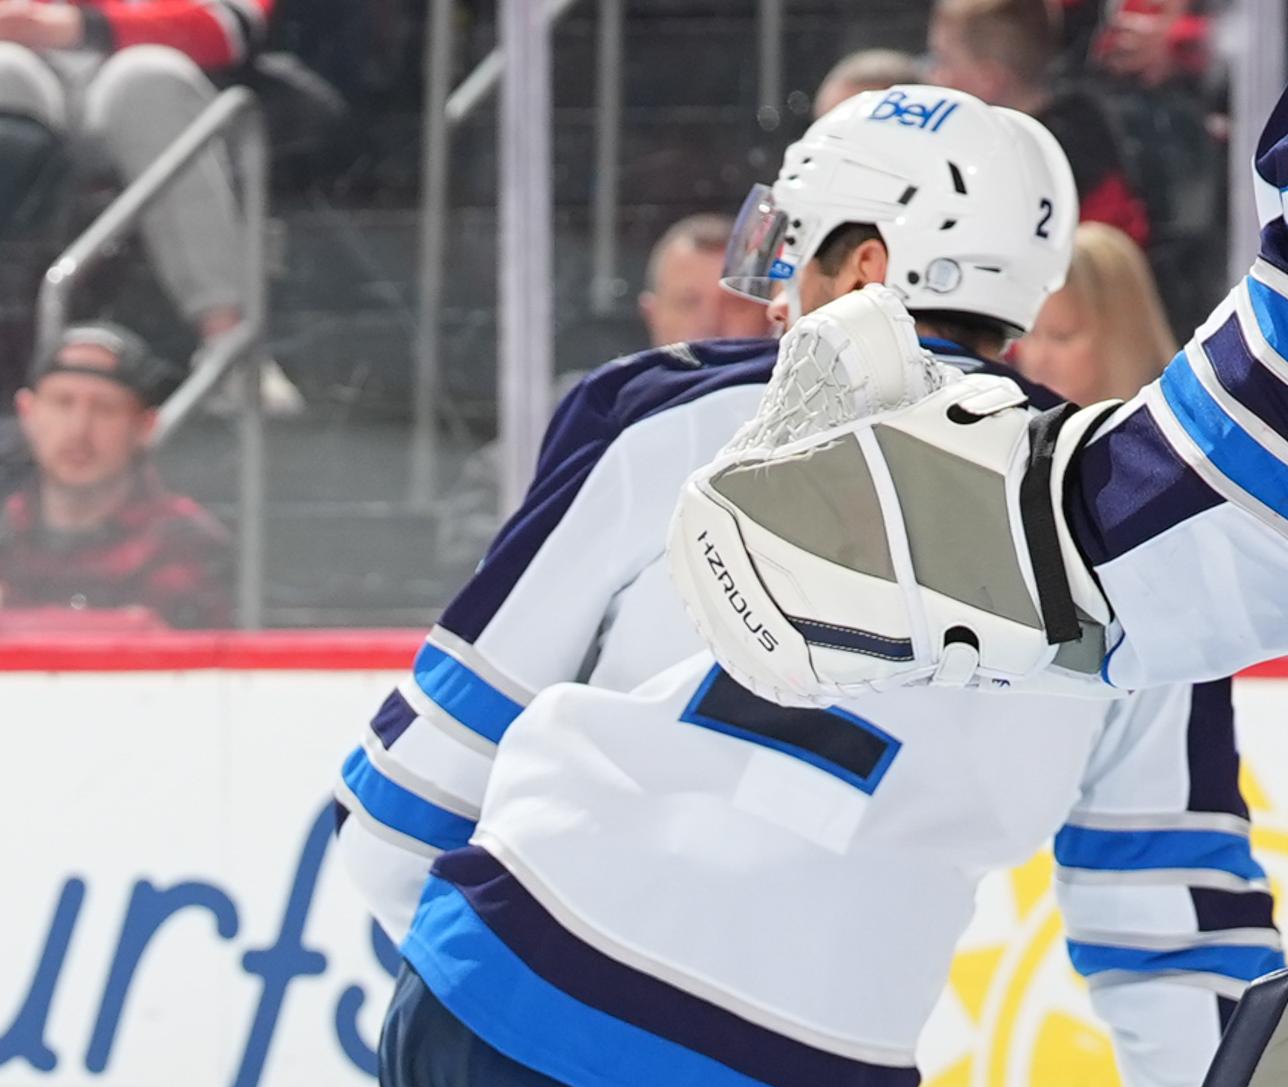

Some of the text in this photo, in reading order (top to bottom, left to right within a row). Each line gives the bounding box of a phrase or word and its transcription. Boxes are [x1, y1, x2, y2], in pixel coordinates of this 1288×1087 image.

[868, 91, 959, 132] Bell
[1035, 197, 1053, 239] 2
[697, 530, 780, 653] HZRDUS
